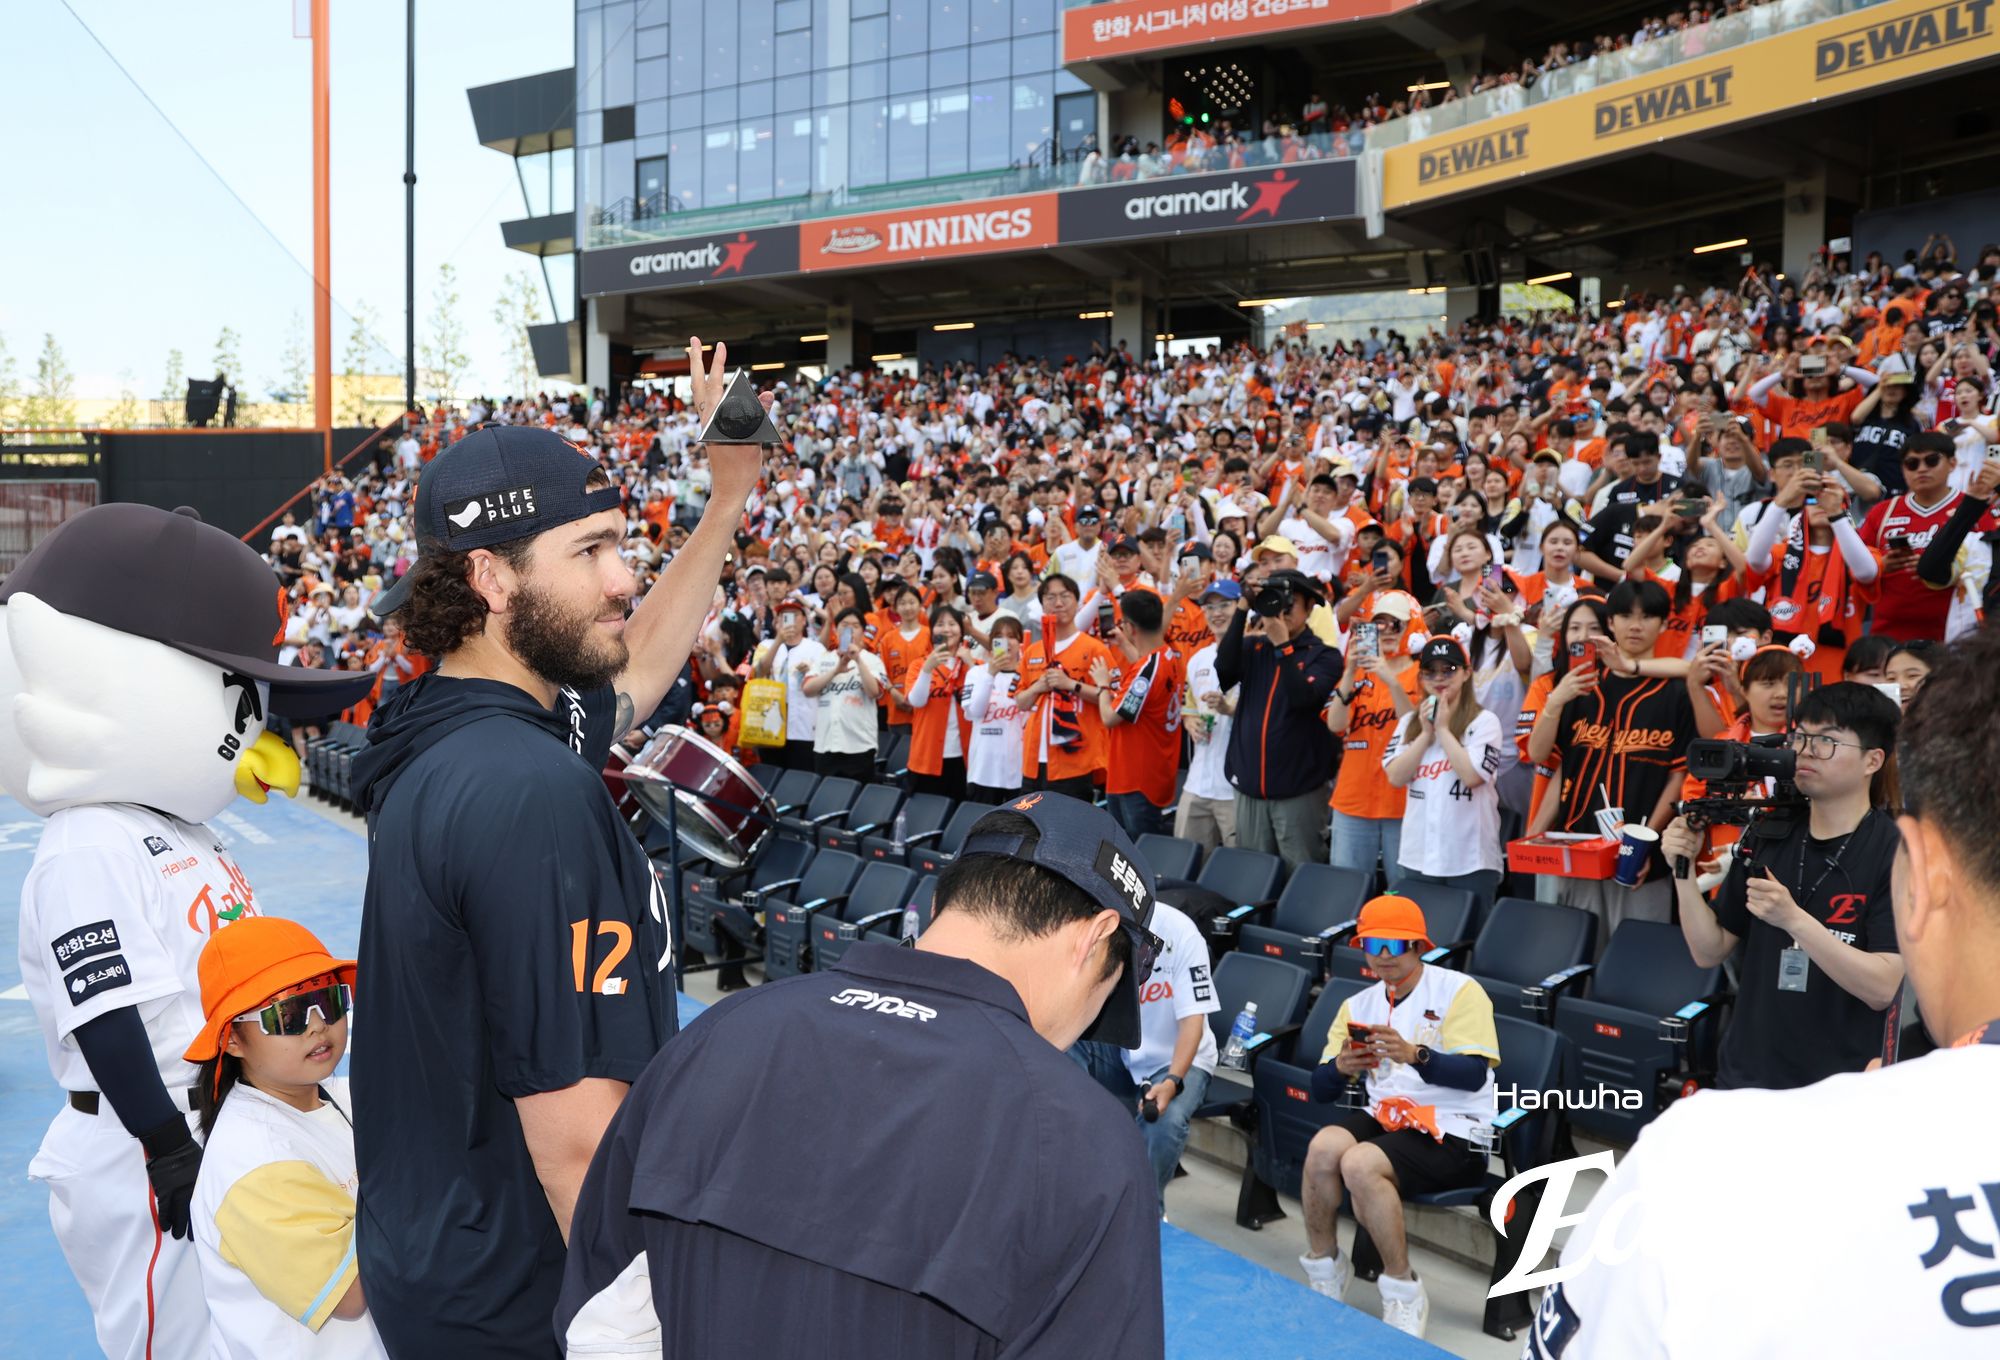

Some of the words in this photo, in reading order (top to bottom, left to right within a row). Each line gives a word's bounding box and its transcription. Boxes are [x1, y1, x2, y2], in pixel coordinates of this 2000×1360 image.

[1093, 19, 1131, 42] 한화
[1134, 5, 1207, 34] 시그니처
[1210, 0, 1248, 22] 여성
[1125, 181, 1249, 220] aramark
[887, 208, 1033, 252] INNINGS
[629, 241, 721, 276] aramark
[485, 488, 533, 508] LIFE
[487, 501, 535, 521] PLUS
[1449, 779, 1473, 801] 44
[1110, 852, 1147, 910] 부루펜
[56, 927, 117, 961] 한화오션
[570, 918, 632, 995] 12
[86, 963, 127, 986] 토스페이
[830, 988, 938, 1022] SPYDER
